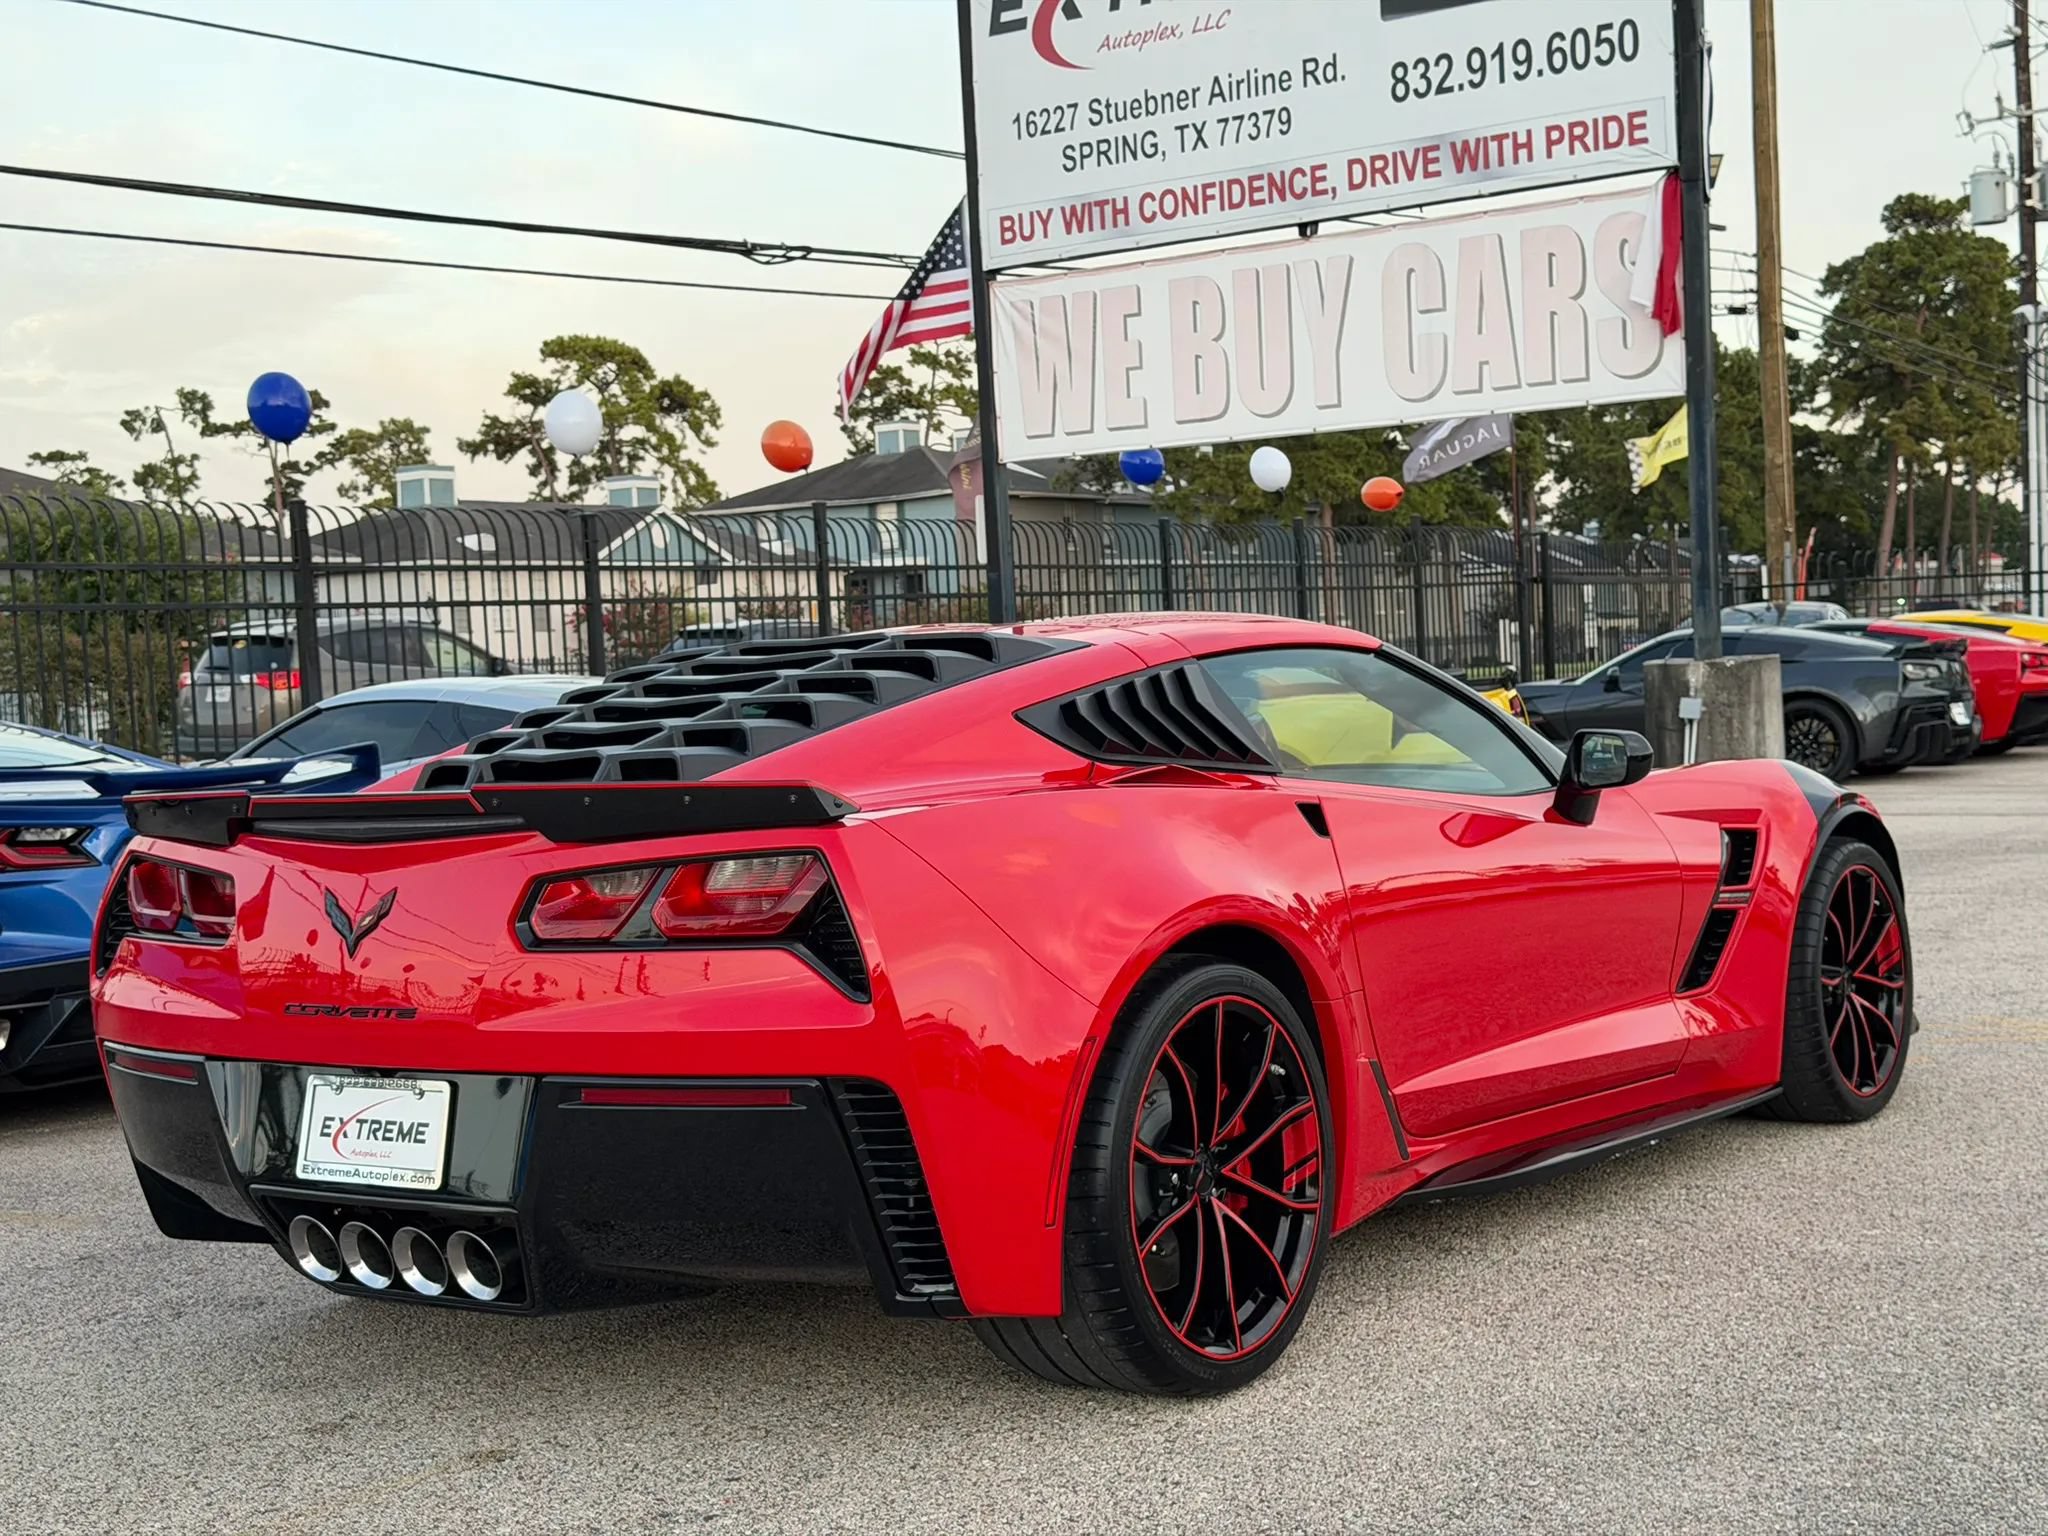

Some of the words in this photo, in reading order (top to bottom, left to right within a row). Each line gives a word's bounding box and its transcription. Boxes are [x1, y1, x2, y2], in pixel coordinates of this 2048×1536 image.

[1097, 20, 1184, 53] Autoplex,
[1191, 8, 1232, 35] LLC
[1390, 18, 1640, 103] 832.919.6050
[1012, 102, 1080, 140] 16227
[1088, 88, 1202, 127] Stuebner
[1208, 67, 1293, 106] Airline
[1302, 53, 1346, 88] Rd.
[1062, 129, 1166, 173] SPRING,
[1174, 120, 1209, 152] TX
[1216, 106, 1292, 146] 77379
[1000, 209, 1053, 246] BUY
[1061, 197, 1130, 234] WITH
[1139, 163, 1337, 224] CONFIDENCE,
[1347, 146, 1441, 191] DRIVE
[1450, 132, 1535, 174] WITH
[1545, 110, 1650, 157] PRIDE
[1013, 283, 1149, 440] WE
[1166, 253, 1354, 425] BUY
[1381, 211, 1664, 402] CARS
[284, 1003, 418, 1020] CORVETTE
[319, 1115, 430, 1144] EXTREME
[301, 1163, 436, 1186] ExtremeAutoplex.com
